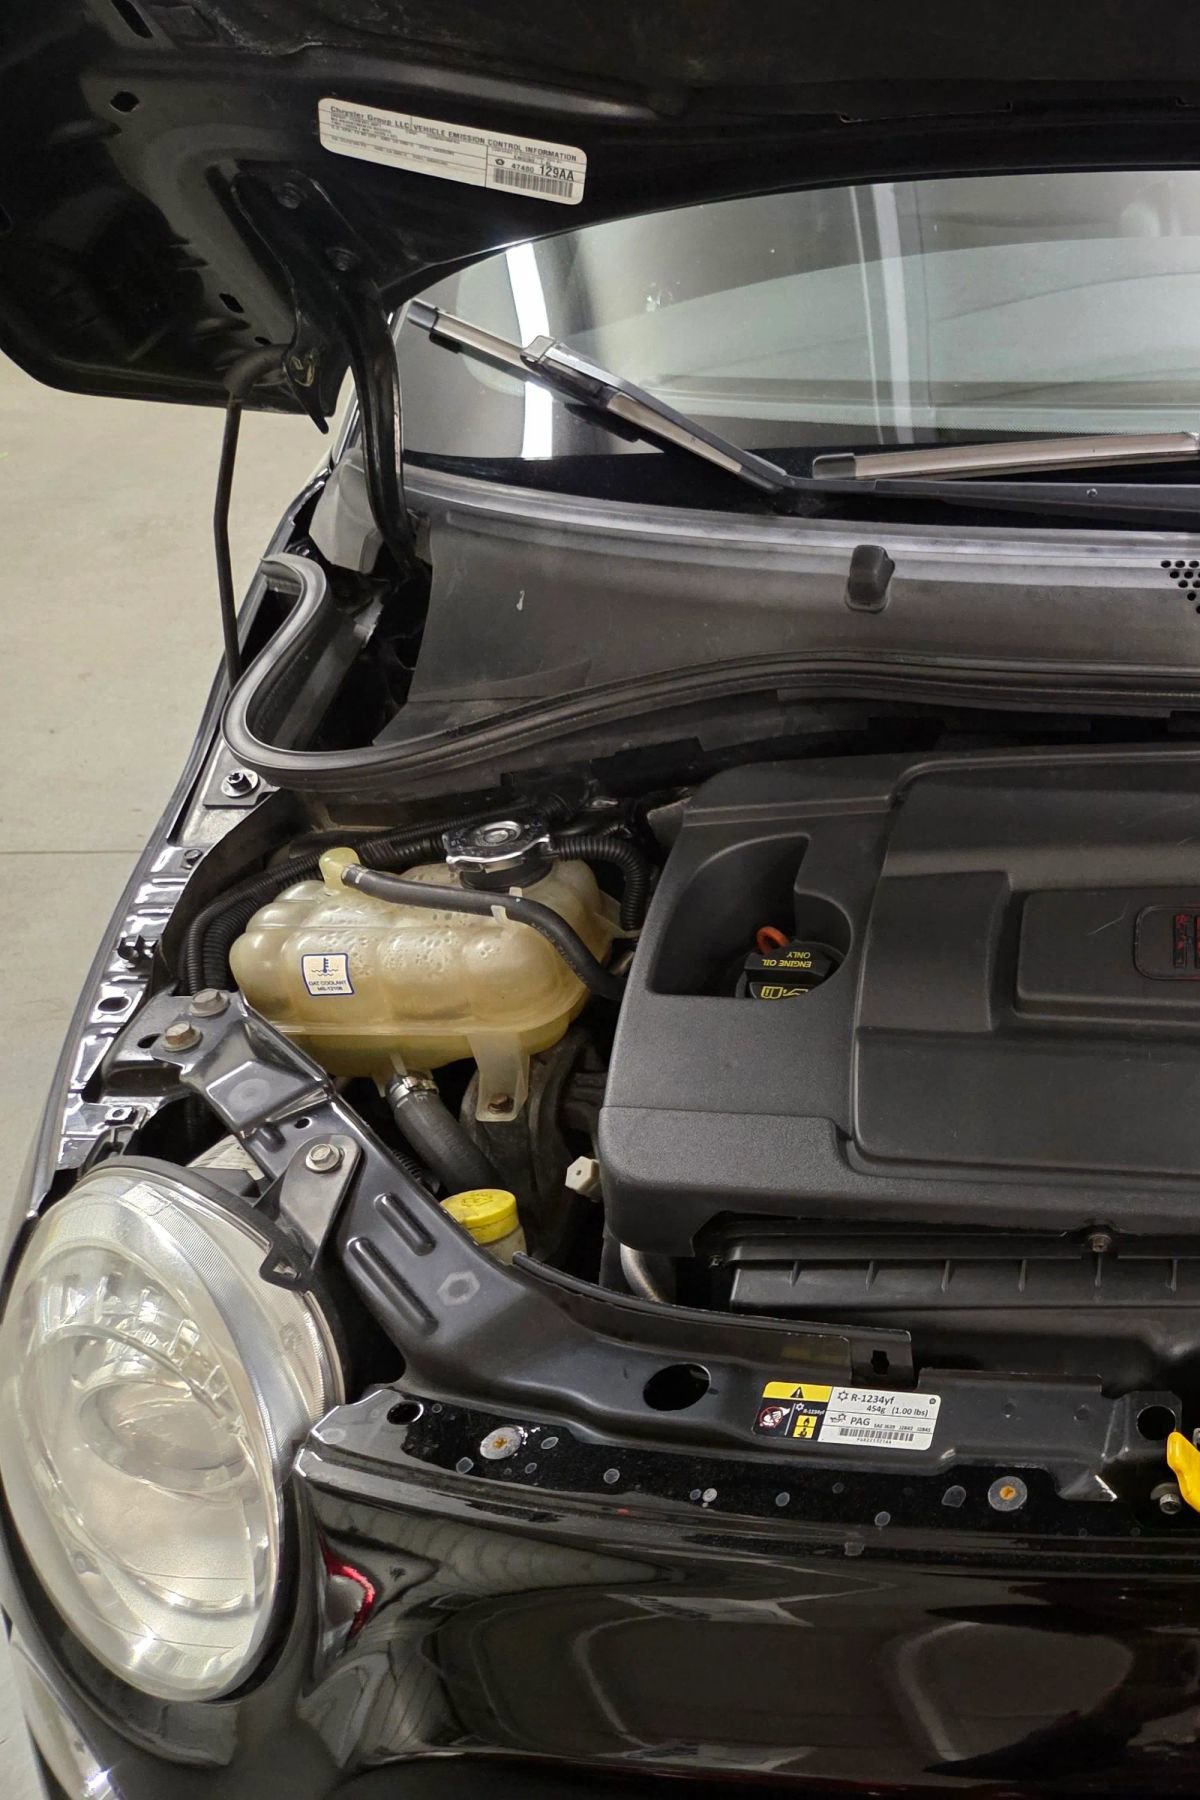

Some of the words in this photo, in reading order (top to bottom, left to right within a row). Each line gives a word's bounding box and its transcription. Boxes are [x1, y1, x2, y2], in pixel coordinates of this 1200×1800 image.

[394, 120, 410, 130] LLC
[413, 124, 445, 136] VEHICLE
[448, 130, 485, 144] EMISSION
[487, 139, 523, 152] CONTROL
[525, 146, 577, 161] INFORMATION
[540, 164, 575, 182] 129AA
[786, 951, 811, 959] ONLY
[762, 959, 777, 967] OIL
[778, 960, 812, 968] ENGINE
[851, 1393, 895, 1406] R-1234yf
[866, 1405, 886, 1415] 454g
[891, 1406, 913, 1417] (1.00
[914, 1408, 929, 1418] lbs)
[850, 1416, 871, 1427] PAG
